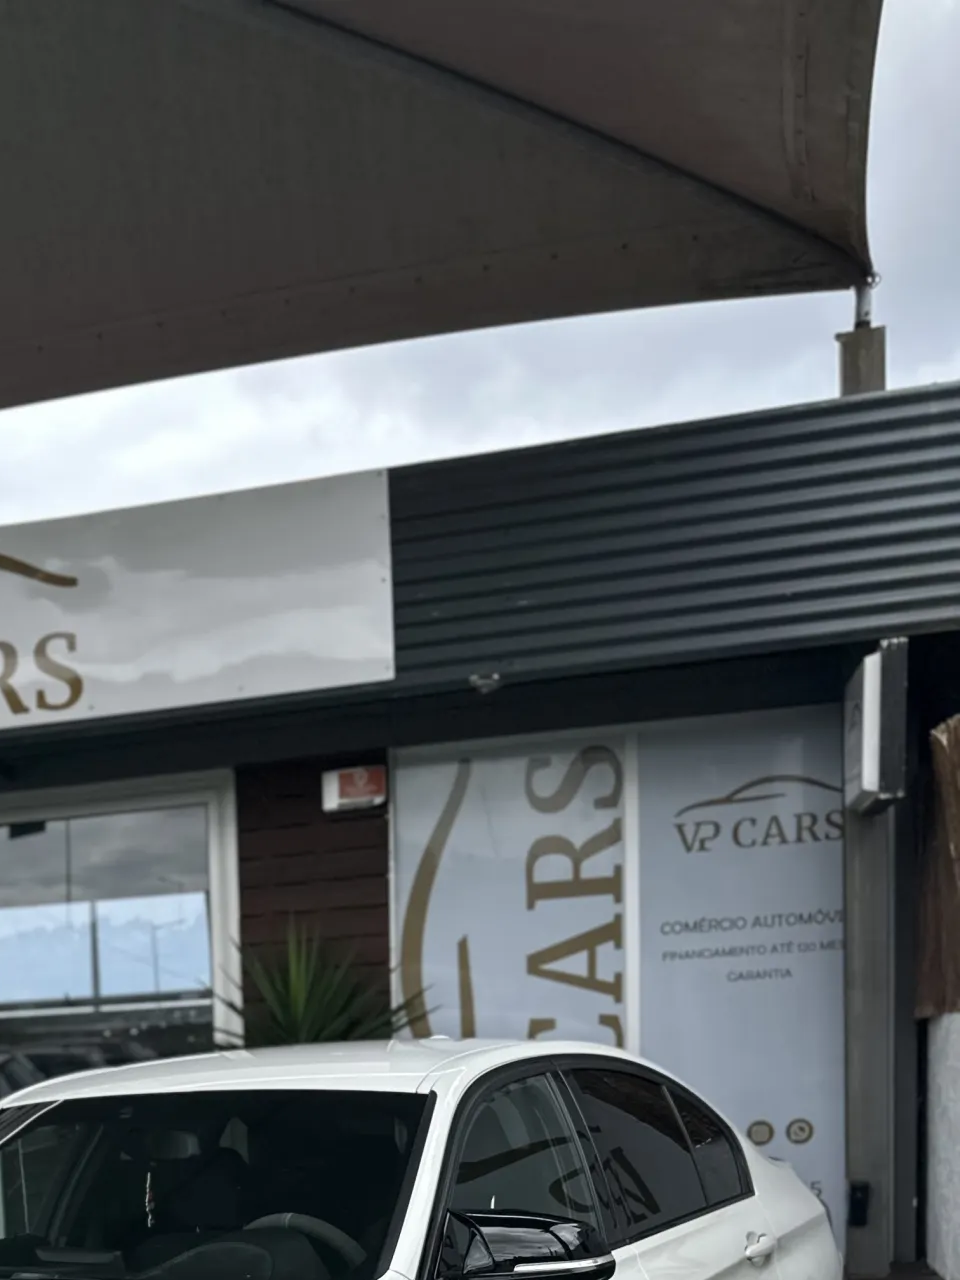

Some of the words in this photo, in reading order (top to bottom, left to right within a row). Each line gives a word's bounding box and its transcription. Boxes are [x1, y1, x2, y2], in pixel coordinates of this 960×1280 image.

[673, 819, 722, 854] VP
[731, 810, 846, 850] CARS
[660, 915, 747, 936] COMÉRCIO
